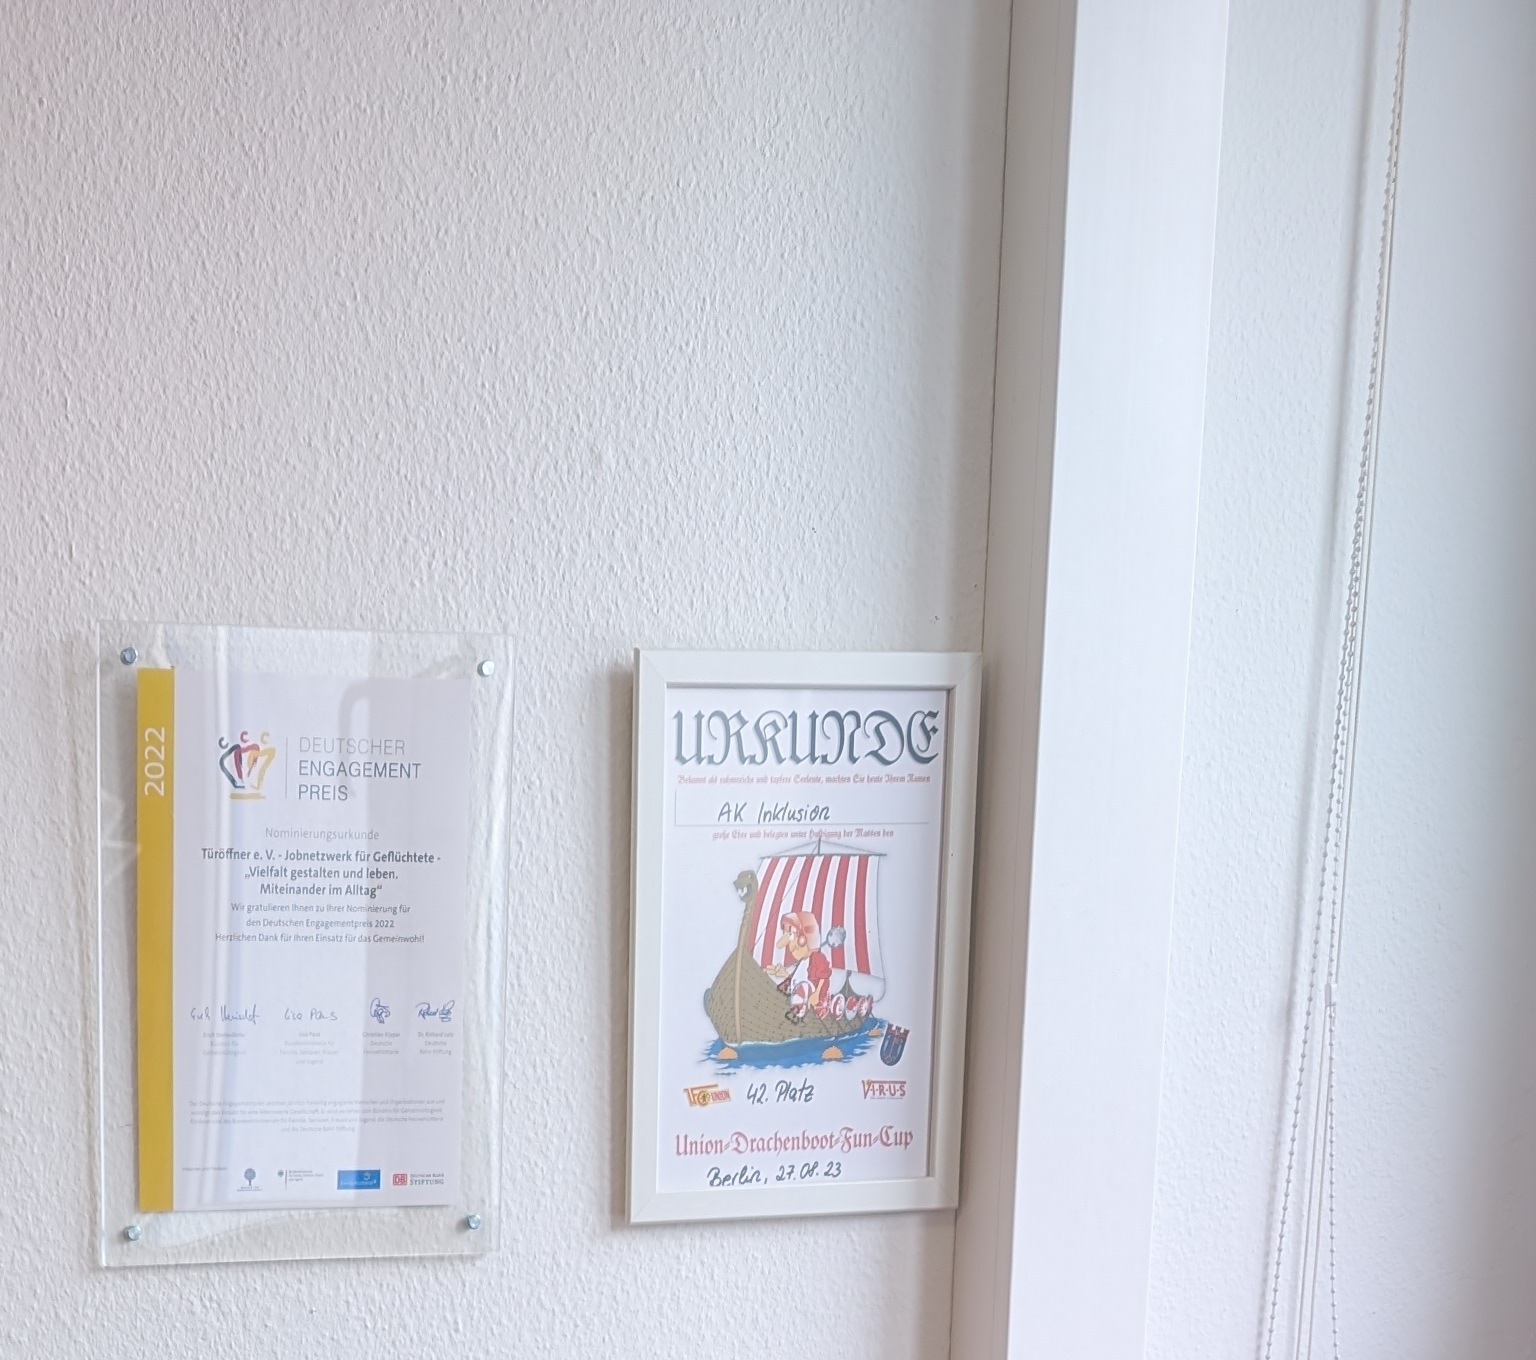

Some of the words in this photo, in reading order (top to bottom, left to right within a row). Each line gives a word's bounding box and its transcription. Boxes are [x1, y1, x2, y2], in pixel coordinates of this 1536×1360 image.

[299, 737, 406, 756] DEUTSCHER
[672, 709, 940, 766] URKUNDE
[144, 726, 166, 797] 2022
[299, 760, 422, 779] ENGAGEMENT
[298, 784, 348, 801] PREIS
[717, 801, 747, 823] AK
[758, 801, 831, 824] Inklusion
[265, 827, 380, 842] Nominierungsurkunde
[201, 848, 251, 861] Türöffner
[284, 849, 352, 862] Jobnetzwerk
[354, 850, 370, 862] für
[372, 850, 435, 863] Geflüchtete
[290, 867, 340, 881] gestalten
[342, 867, 363, 879] und
[259, 884, 327, 896] Miteinander
[328, 884, 342, 896] im
[346, 904, 398, 915] Nominierung
[399, 905, 411, 913] für
[246, 918, 261, 927] den
[263, 919, 304, 928] Deutschen
[306, 919, 373, 930] Engagementpreis
[374, 919, 395, 928] 2022
[775, 1077, 815, 1104] Platz
[707, 1164, 768, 1187] Berlin,
